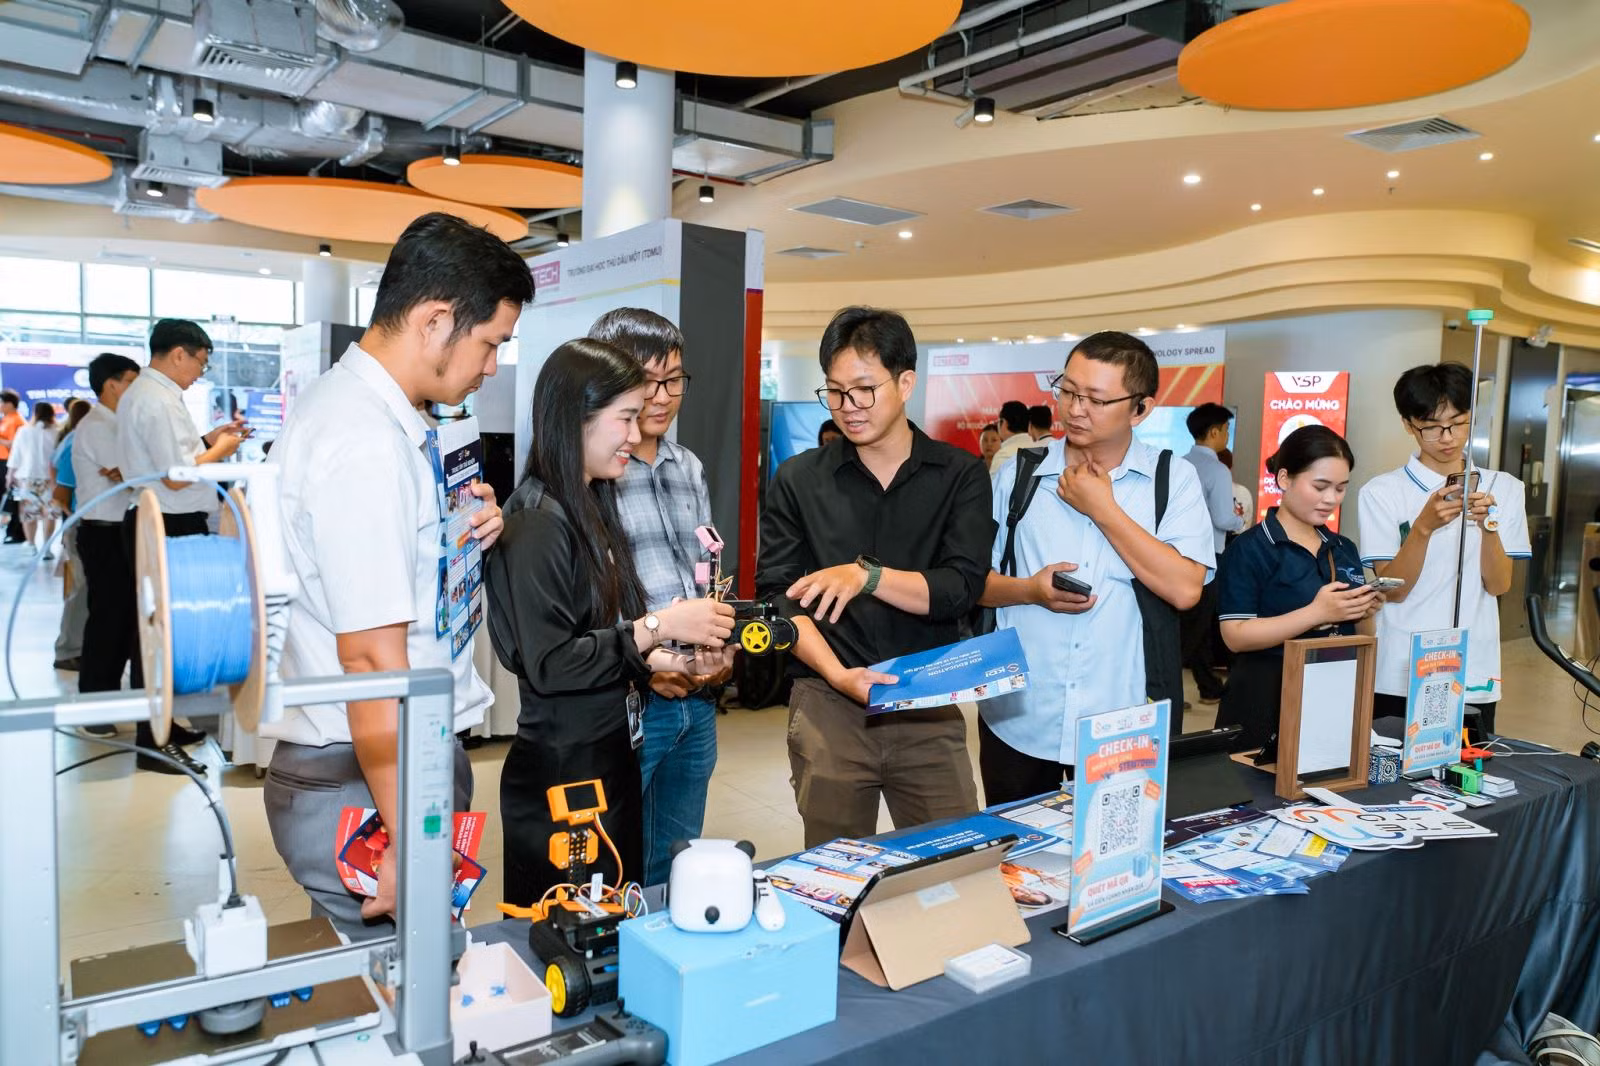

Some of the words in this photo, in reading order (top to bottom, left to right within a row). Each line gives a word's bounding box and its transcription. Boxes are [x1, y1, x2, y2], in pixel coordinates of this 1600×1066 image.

[532, 262, 560, 286] TECH
[1153, 348, 1182, 358] NOLOGY
[1184, 346, 1215, 356] SPREAD
[1269, 397, 1303, 411] CHÀO
[1424, 649, 1458, 661] CHECK-IN
[928, 661, 969, 677] EDUCATION
[985, 666, 1005, 678] KDI
[1099, 734, 1150, 758] CHECK-IN
